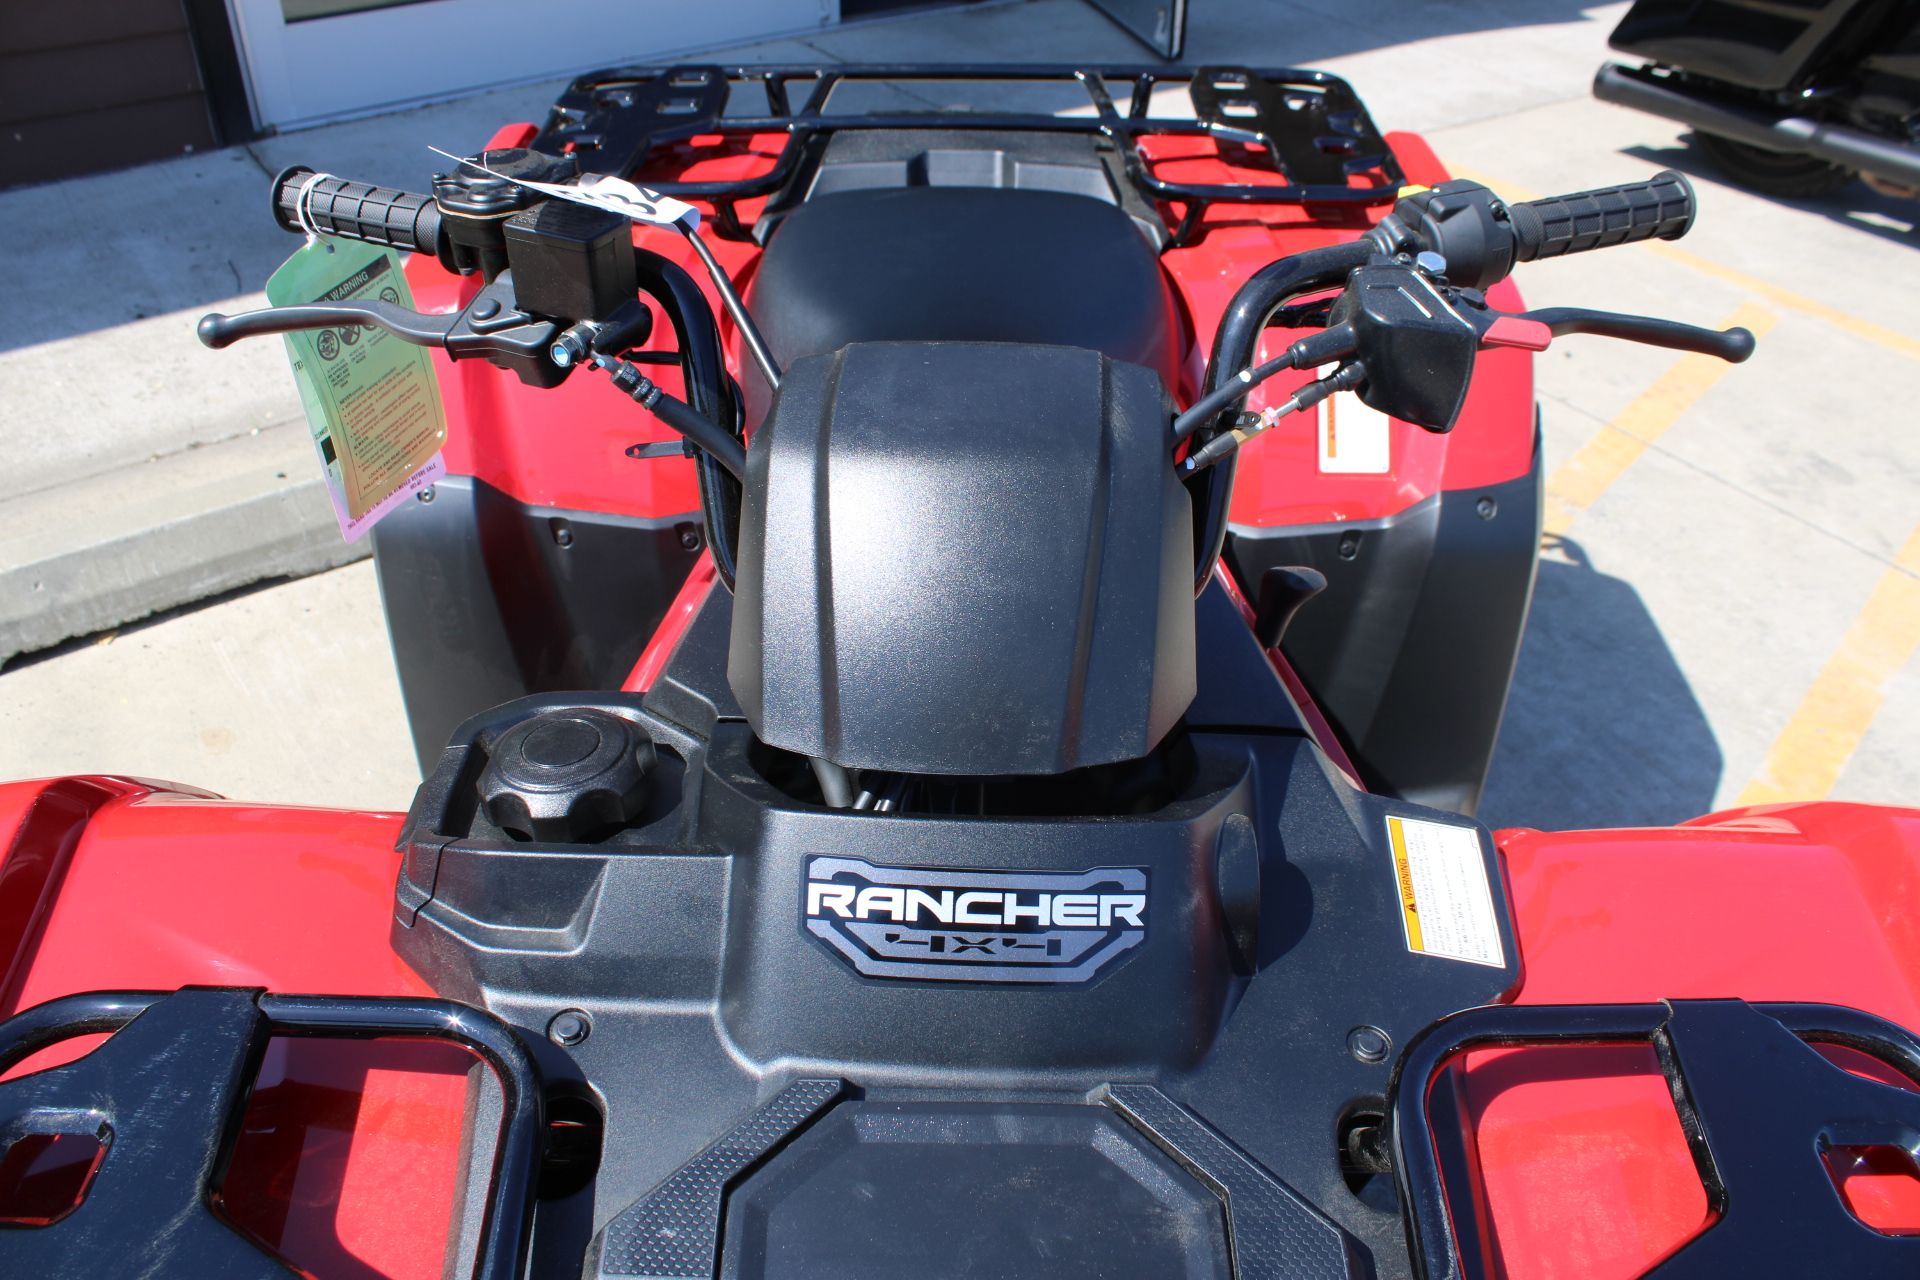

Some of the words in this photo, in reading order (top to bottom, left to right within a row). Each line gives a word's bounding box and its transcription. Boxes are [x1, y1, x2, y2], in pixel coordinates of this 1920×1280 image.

[330, 271, 369, 301] WARNING
[1398, 857, 1416, 900] WARNING
[806, 882, 1147, 927] RANCHER
